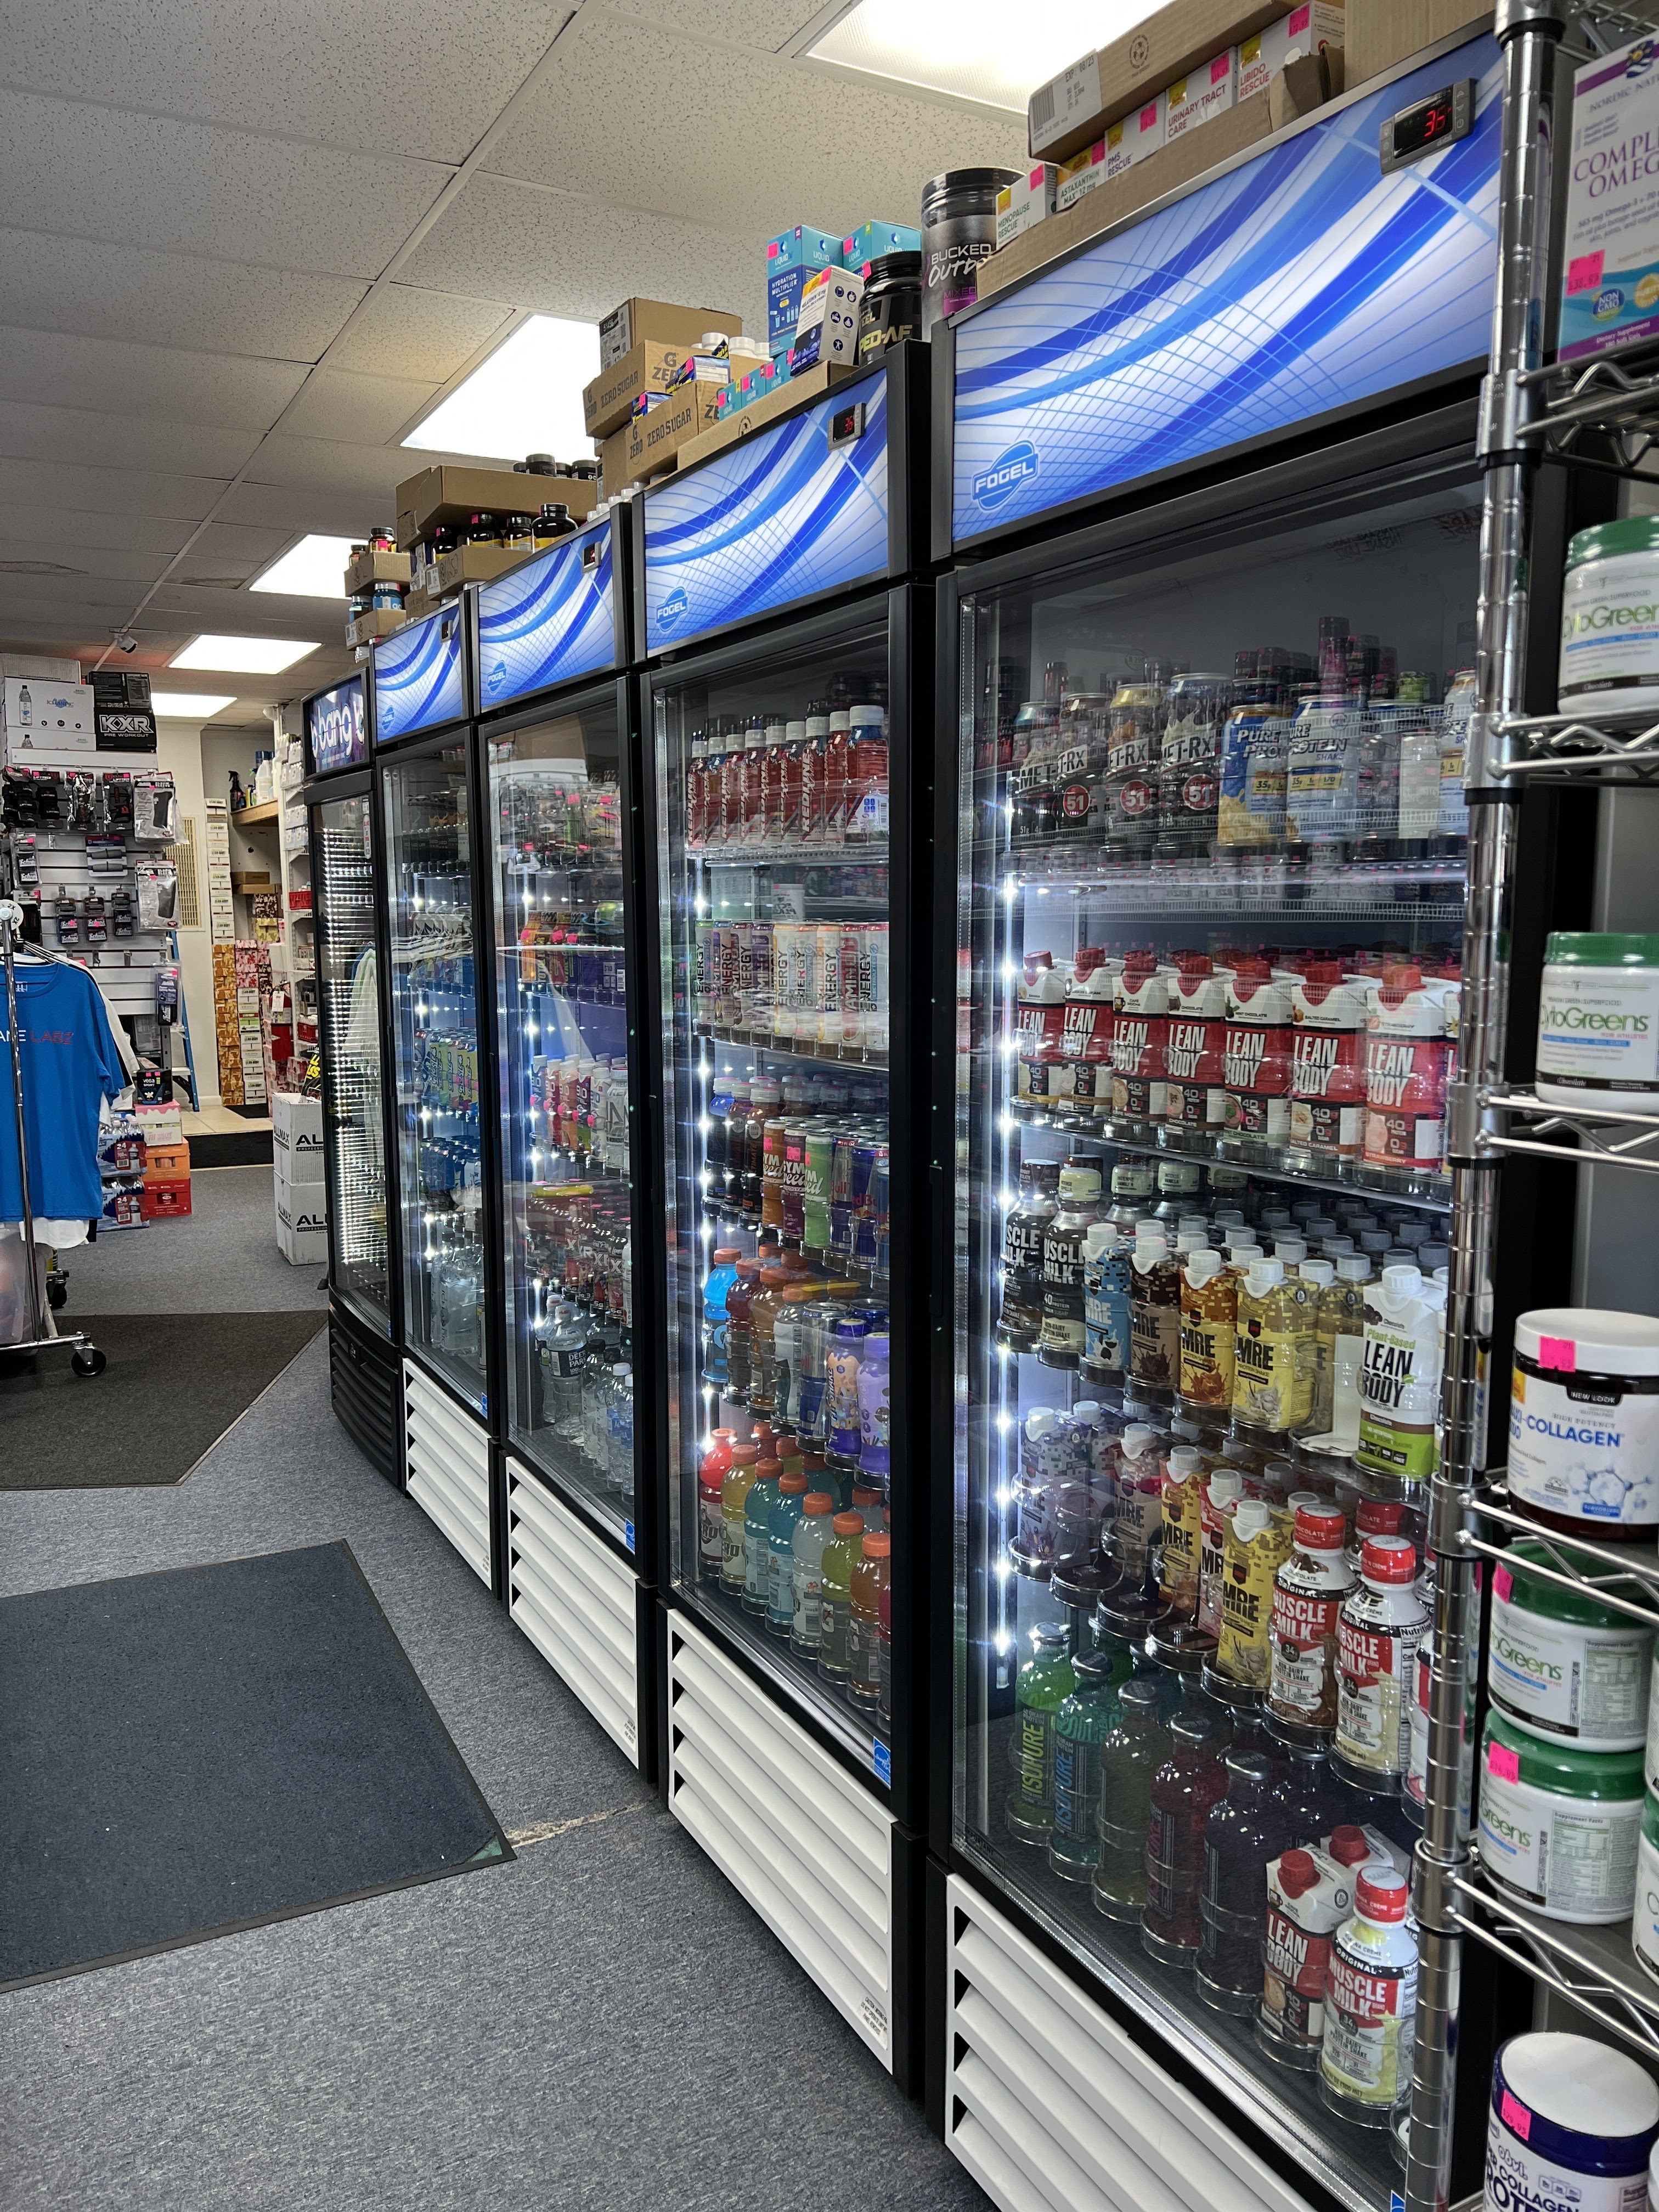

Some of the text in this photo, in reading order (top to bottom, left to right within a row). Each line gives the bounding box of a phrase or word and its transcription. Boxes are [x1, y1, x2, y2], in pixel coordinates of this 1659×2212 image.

[1240, 63, 1266, 86] LIBIDO
[1240, 72, 1270, 98] RESCUE
[1169, 101, 1199, 127] URINARY
[1201, 83, 1226, 106] TRACT
[1168, 119, 1187, 138] CARE
[1108, 151, 1121, 167] PMS
[1108, 155, 1132, 177] RESCUE
[1574, 125, 1659, 182] COMPL
[1060, 168, 1100, 199] ASTAXANTHIN
[997, 201, 1031, 230] MENOPAUSE
[997, 221, 1018, 239] RESCUE
[775, 254, 789, 266] LIQUID
[813, 251, 830, 262] LIQUID
[931, 243, 992, 266] BUCKED
[772, 273, 797, 288] HYDRATION
[772, 279, 797, 296] MULTIPLIER
[943, 286, 976, 300] MIXED
[1597, 298, 1619, 313] GMO
[1599, 290, 1619, 304] NON
[601, 370, 639, 408] ZERO SUGAR
[585, 400, 597, 420] ZERO
[647, 408, 692, 448] ZERO SUGAR
[629, 438, 644, 460] ZERO
[975, 462, 1035, 493] FOGEL
[657, 601, 686, 620] FOGEL
[487, 670, 507, 685] FOGEL
[99, 714, 154, 733] KXR
[318, 704, 353, 757] bang
[1237, 730, 1282, 743] PURE
[1316, 753, 1345, 761] SHAKE
[1066, 795, 1085, 810] 51
[1125, 789, 1146, 807] 51
[1188, 786, 1210, 803] 51
[721, 944, 731, 996] ENERGY
[778, 950, 788, 1005] ENERGY
[825, 953, 837, 1012] ENERGY
[1019, 1009, 1046, 1032] LEAN
[1064, 1006, 1096, 1033] LEAN
[30, 1030, 74, 1045] LABZ
[1114, 1020, 1148, 1047] LEAN
[1169, 1023, 1206, 1052] LEAN
[1226, 1030, 1266, 1060] LEAN
[1113, 1046, 1144, 1073] BODY
[1294, 1035, 1339, 1064] LEAN
[1369, 1042, 1415, 1076] LEAN
[1167, 1048, 1200, 1079] BODY
[1224, 1056, 1260, 1088] BODY
[1292, 1060, 1333, 1097] BODY
[1367, 1073, 1409, 1108] BODY
[1043, 1294, 1053, 1305] 40
[1085, 1299, 1113, 1324] MRE
[1132, 1309, 1160, 1340] MRE
[1182, 1326, 1216, 1359] MRE
[1367, 1328, 1417, 1350] Plant-Based
[568, 1350, 586, 1362] DEER
[1237, 1336, 1274, 1372] MRE
[1364, 1340, 1414, 1379] LEAN
[1362, 1372, 1405, 1408] BODY
[1571, 1391, 1616, 1404] NEW LOOK
[1116, 1496, 1145, 1529] MRE
[1277, 1578, 1318, 1599] ORIGINAL
[1223, 1586, 1260, 1622] MRE
[1276, 1617, 1312, 1641] MILK
[1021, 1720, 1045, 1795] ISOPURE
[1554, 1812, 1588, 1822] Supplement
[1267, 1912, 1309, 1965] LEAN
[1336, 1947, 1376, 1975] ORIGINAL
[1328, 1955, 1387, 2004] MUSCLE
[1333, 1981, 1372, 2019] MILK
